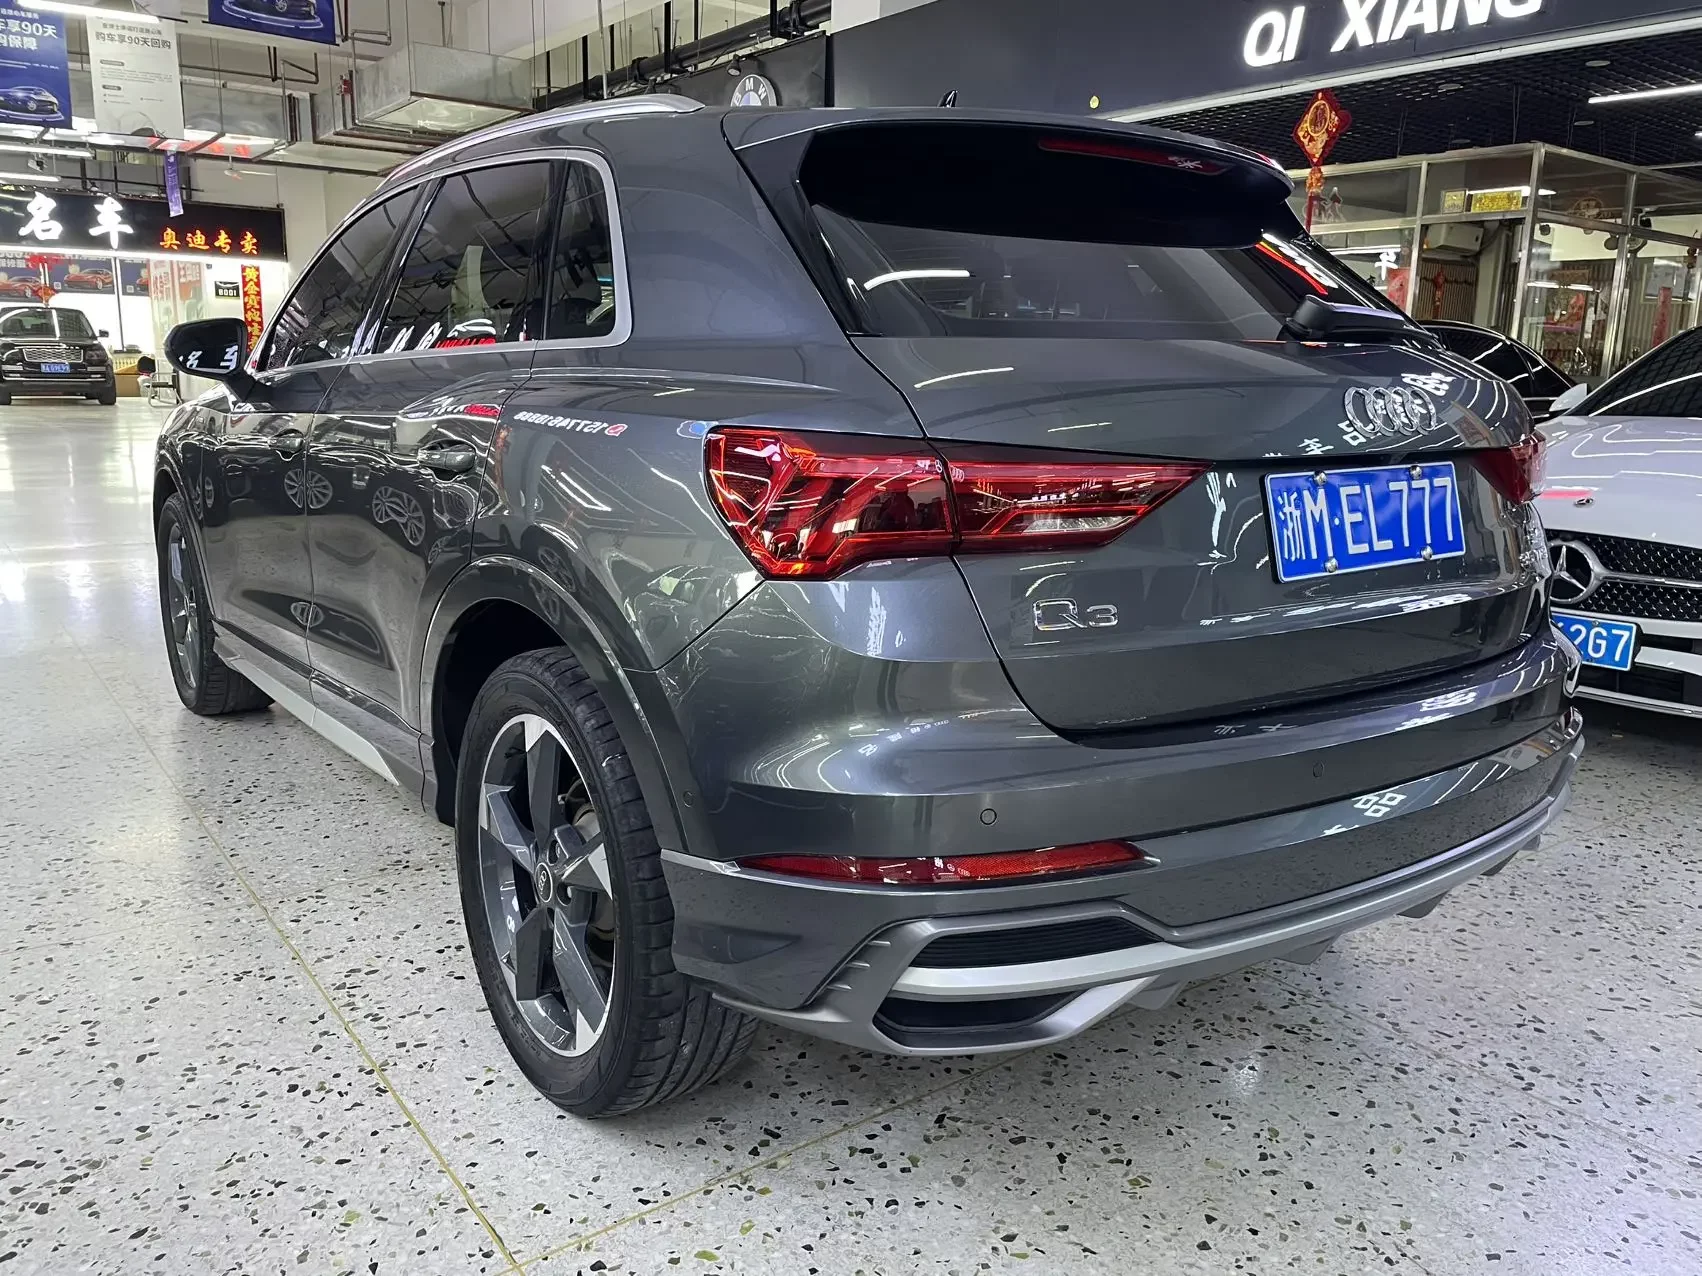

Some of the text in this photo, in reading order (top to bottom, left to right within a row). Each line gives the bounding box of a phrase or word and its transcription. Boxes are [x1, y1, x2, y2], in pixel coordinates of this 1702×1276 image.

[1243, 6, 1305, 67] QI
[18, 191, 134, 249] 名车
[159, 226, 258, 255] 奥迪专卖
[1033, 597, 1118, 631] Q3
